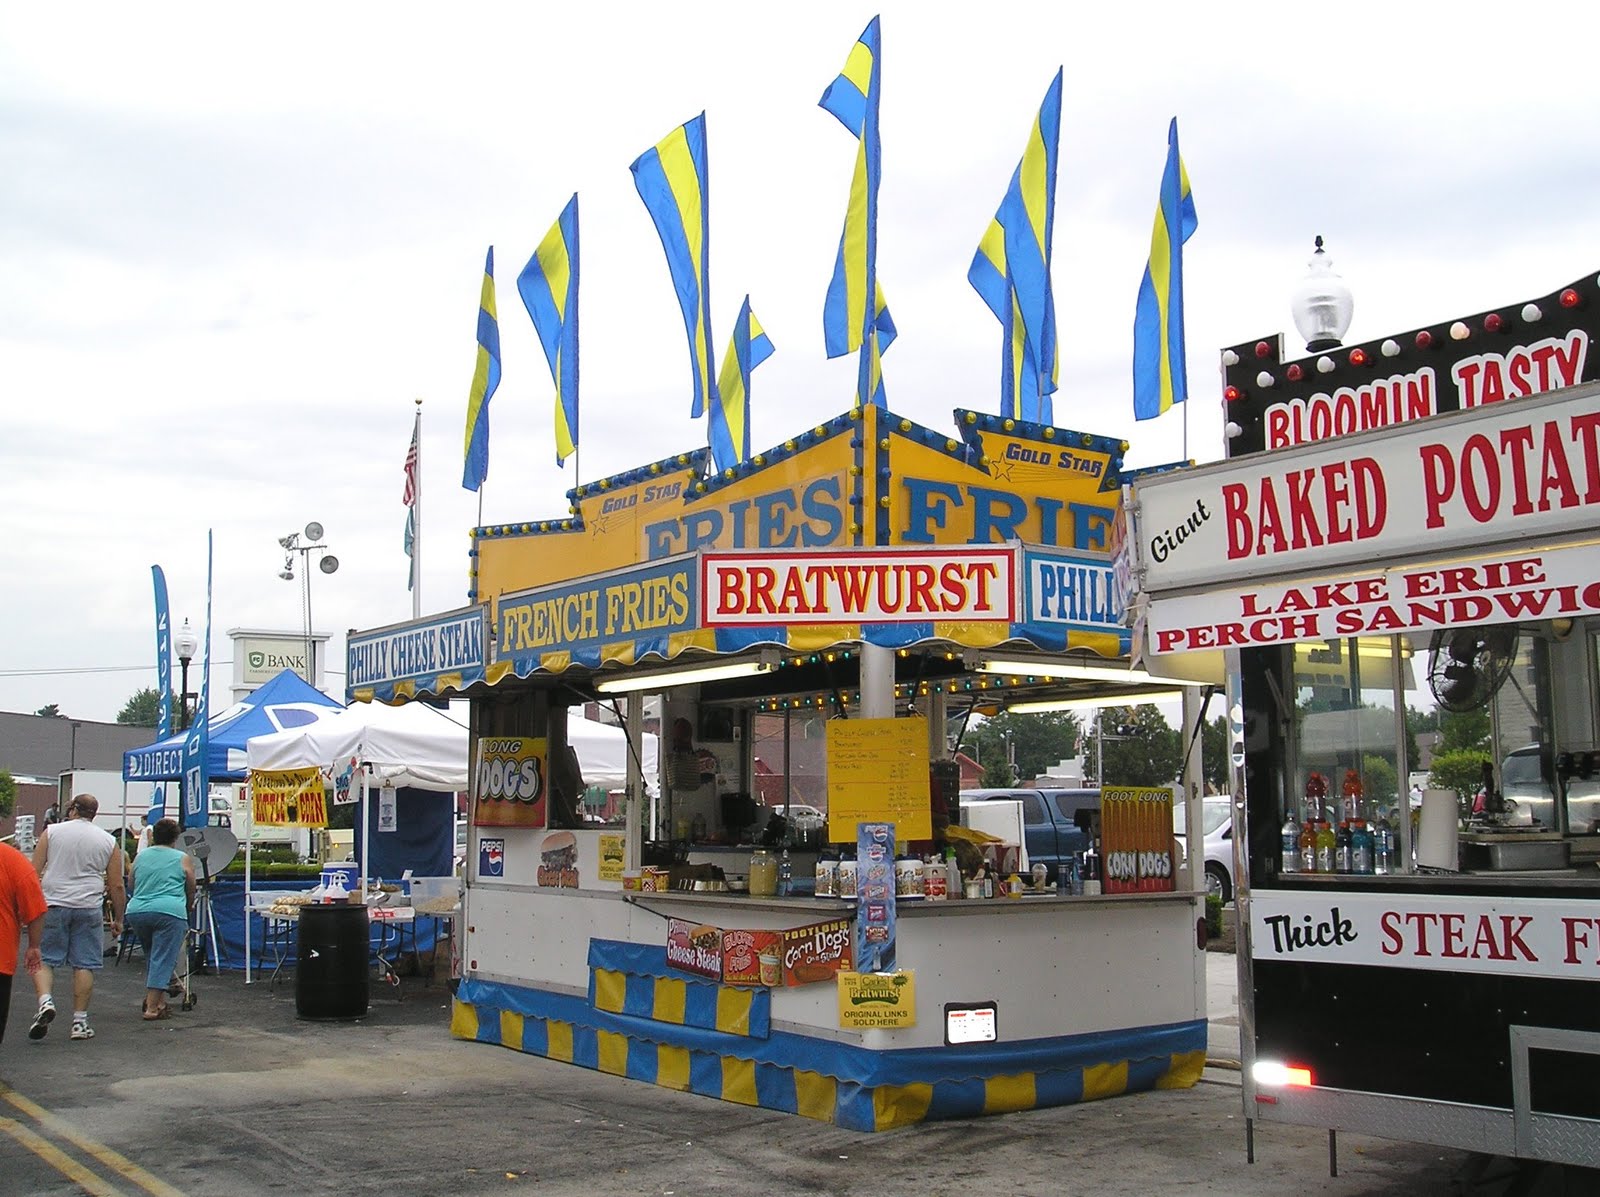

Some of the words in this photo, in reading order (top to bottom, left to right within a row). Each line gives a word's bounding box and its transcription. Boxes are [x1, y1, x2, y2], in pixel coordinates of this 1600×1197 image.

[1267, 370, 1434, 452] BLOOMIN
[1456, 335, 1583, 409] TASTY
[1006, 442, 1054, 465] GOLD
[1057, 451, 1104, 479] STAR
[602, 494, 638, 514] GOLD
[643, 481, 682, 503] STAR
[1221, 456, 1388, 561] BAKED
[1419, 410, 1600, 530] POTAT
[644, 474, 844, 560] FRIES
[1150, 499, 1212, 564] Giant
[716, 561, 999, 616] BRATWURST
[1240, 575, 1390, 619] LAKE
[1403, 557, 1546, 599] ERIE
[502, 589, 600, 652] FRENCH
[604, 571, 690, 637] FRIES
[1156, 611, 1321, 653] PERCH
[267, 654, 305, 668] BANK
[349, 639, 388, 686] PHILLY
[391, 628, 436, 678] CHEESE
[440, 618, 480, 670] STEAK
[480, 756, 540, 801] DOGS
[1104, 791, 1135, 801] FOOT
[1138, 791, 1169, 802] LONG
[299, 792, 325, 823] CORN
[481, 840, 503, 853] PEPSI
[1107, 850, 1138, 882] CORN
[1139, 850, 1172, 878] DOGS
[785, 920, 848, 940] FOOTLONG
[785, 941, 813, 969] Corn
[815, 928, 850, 958] Dogs
[1264, 907, 1358, 954] Thick
[1380, 911, 1539, 963] STEAK
[1561, 917, 1600, 966] F
[667, 938, 696, 965] Cheese
[696, 946, 720, 973] Steak
[849, 986, 901, 998] Bratwurst
[843, 1010, 883, 1018] ORIGINAL
[883, 1010, 908, 1018] LINKS
[853, 1018, 875, 1026] SOLD
[876, 1018, 899, 1026] HERE
